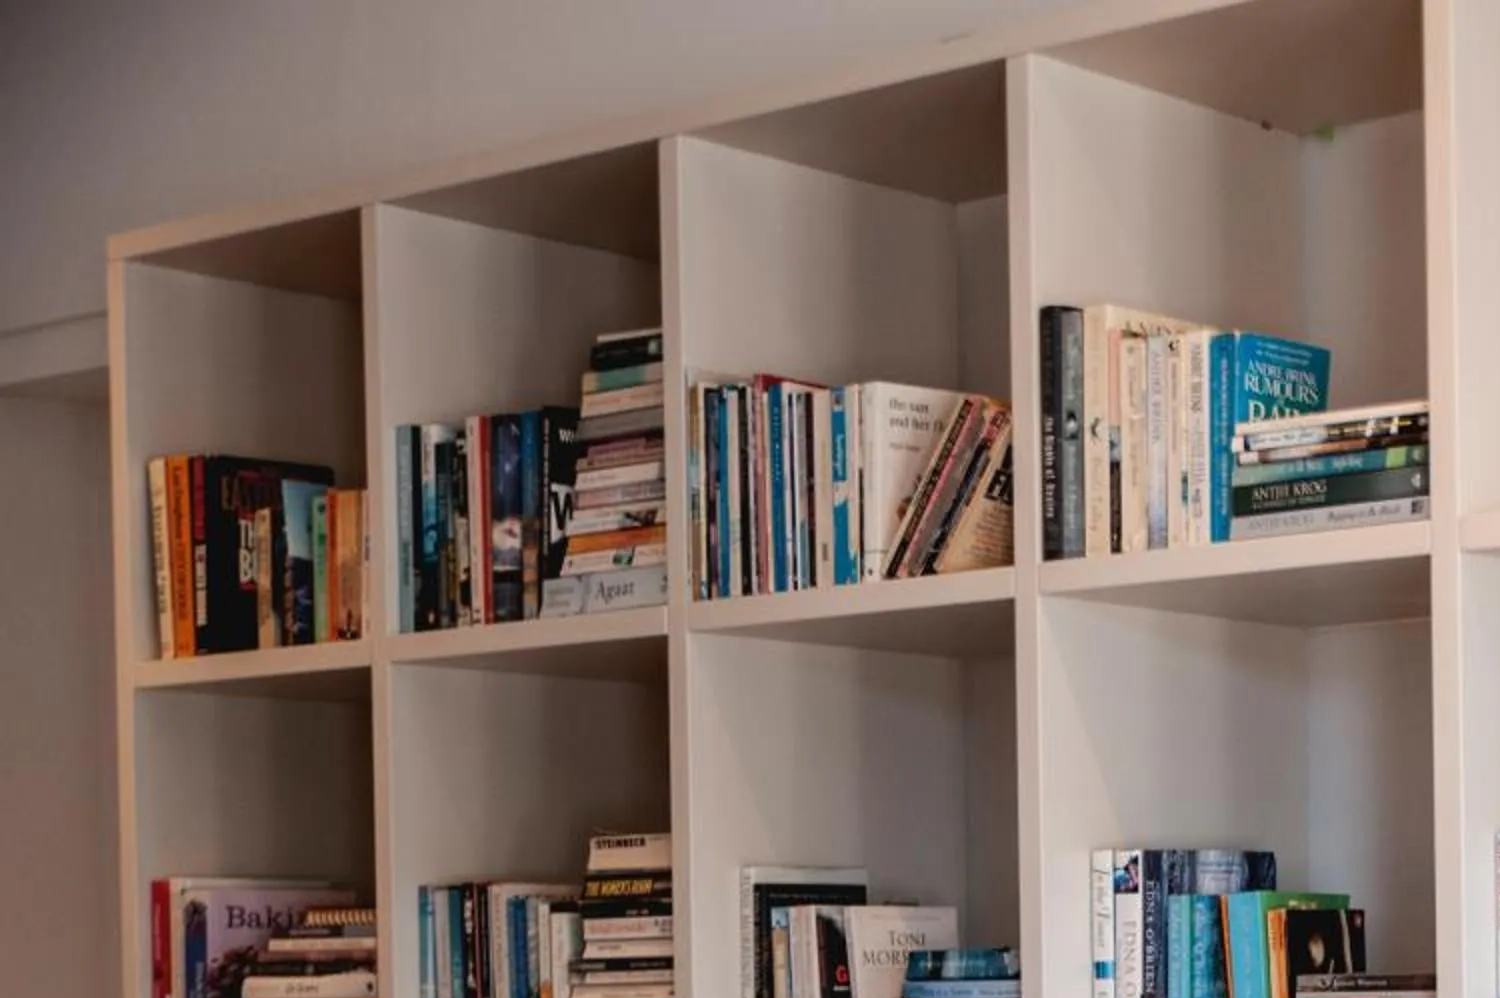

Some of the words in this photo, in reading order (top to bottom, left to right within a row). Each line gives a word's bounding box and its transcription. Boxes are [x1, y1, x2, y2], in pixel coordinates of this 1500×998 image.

[1244, 371, 1320, 407] RUMOURS
[1145, 880, 1156, 925] EDNA
[888, 930, 925, 946] TONI
[1122, 920, 1138, 975] EDNA
[1145, 928, 1156, 994] O'BRIEN
